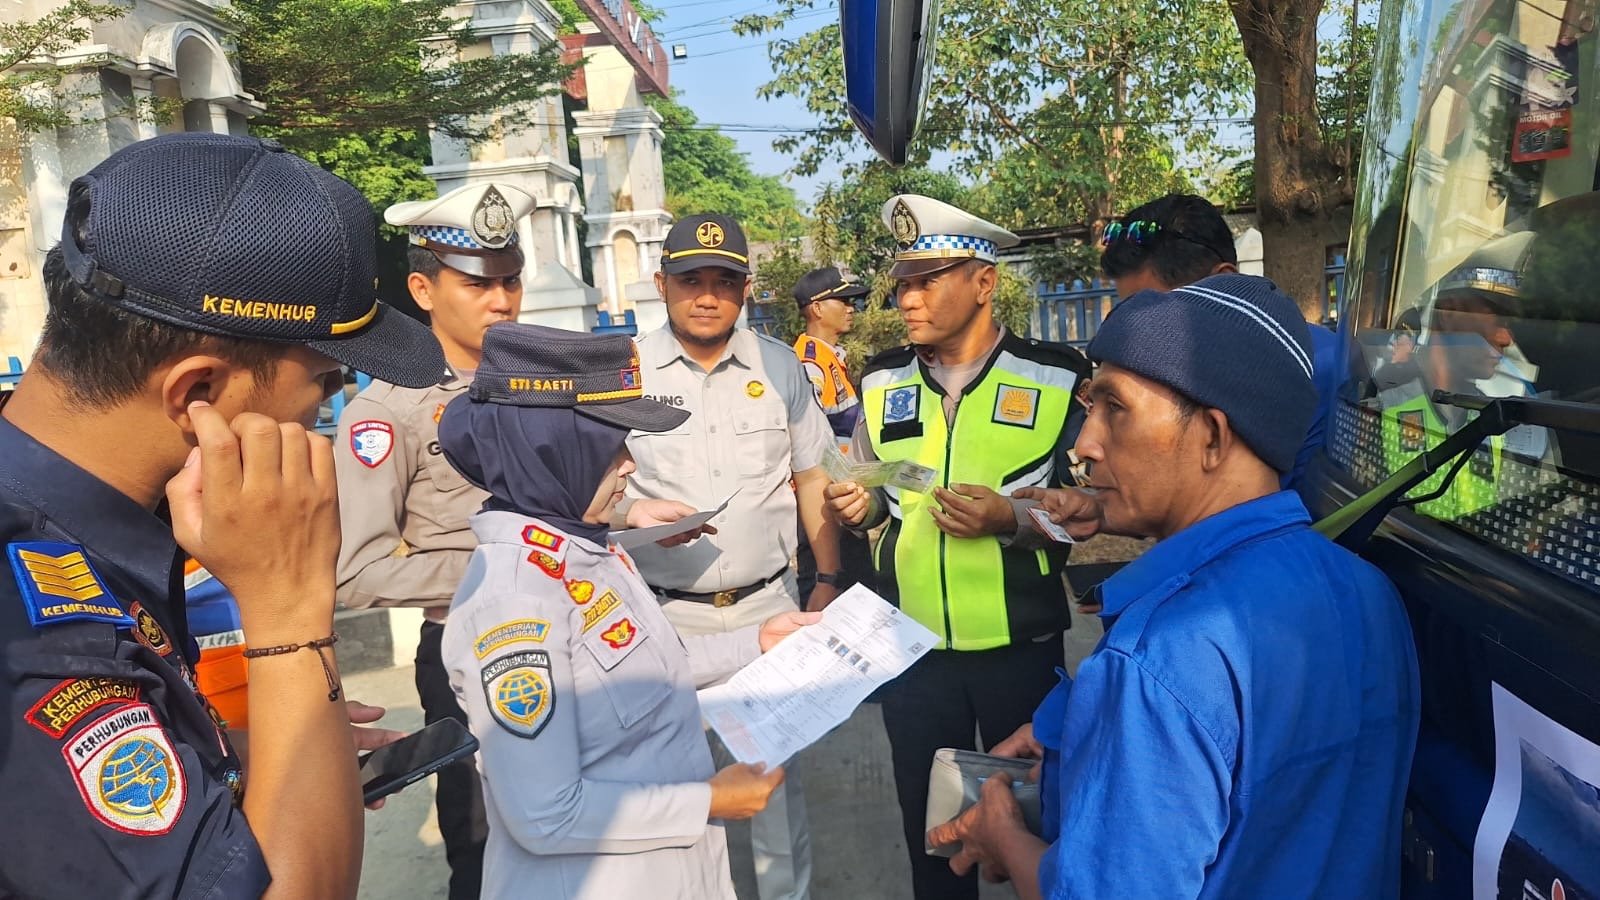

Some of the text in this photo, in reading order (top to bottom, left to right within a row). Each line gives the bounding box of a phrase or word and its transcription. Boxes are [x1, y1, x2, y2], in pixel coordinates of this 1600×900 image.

[202, 294, 317, 322] KEMENHUB
[510, 378, 573, 391] ETI SAETI
[42, 603, 124, 617] KEMENHUB
[484, 653, 548, 682] PERHUBUNGAN
[50, 684, 136, 731] PERHUBUNGAN
[75, 711, 151, 758] PERHUBUNGAN
